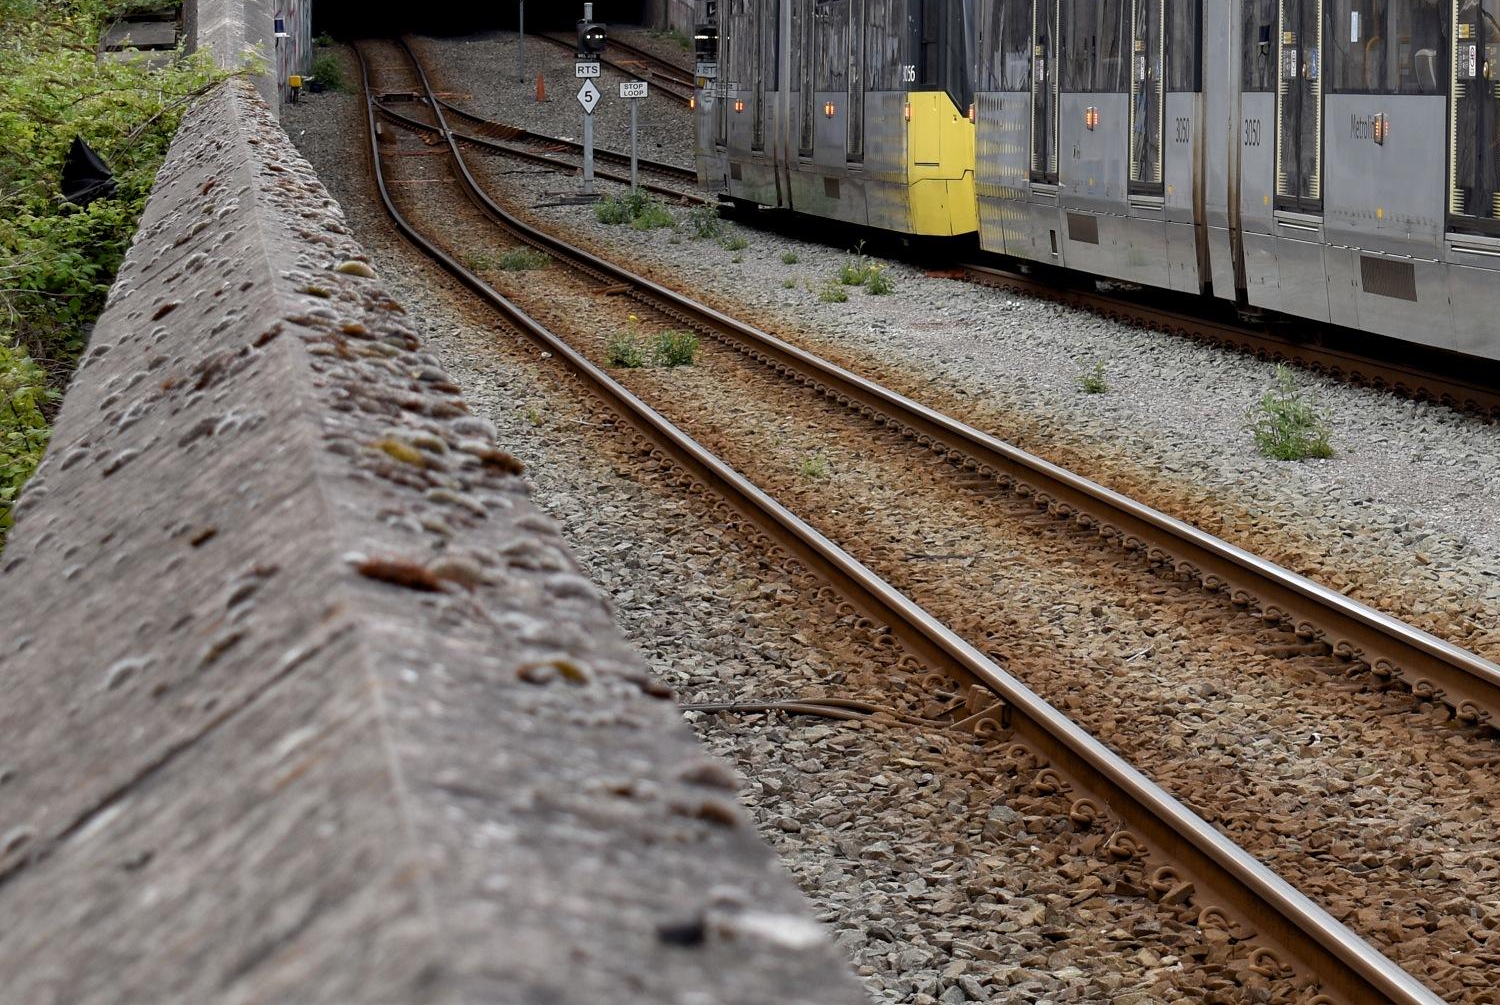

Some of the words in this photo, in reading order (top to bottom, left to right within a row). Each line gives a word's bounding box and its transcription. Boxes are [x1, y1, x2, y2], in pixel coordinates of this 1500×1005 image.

[577, 65, 598, 74] RTS
[584, 90, 593, 102] 5
[1175, 117, 1190, 143] 3050
[1244, 119, 1261, 146] 3050
